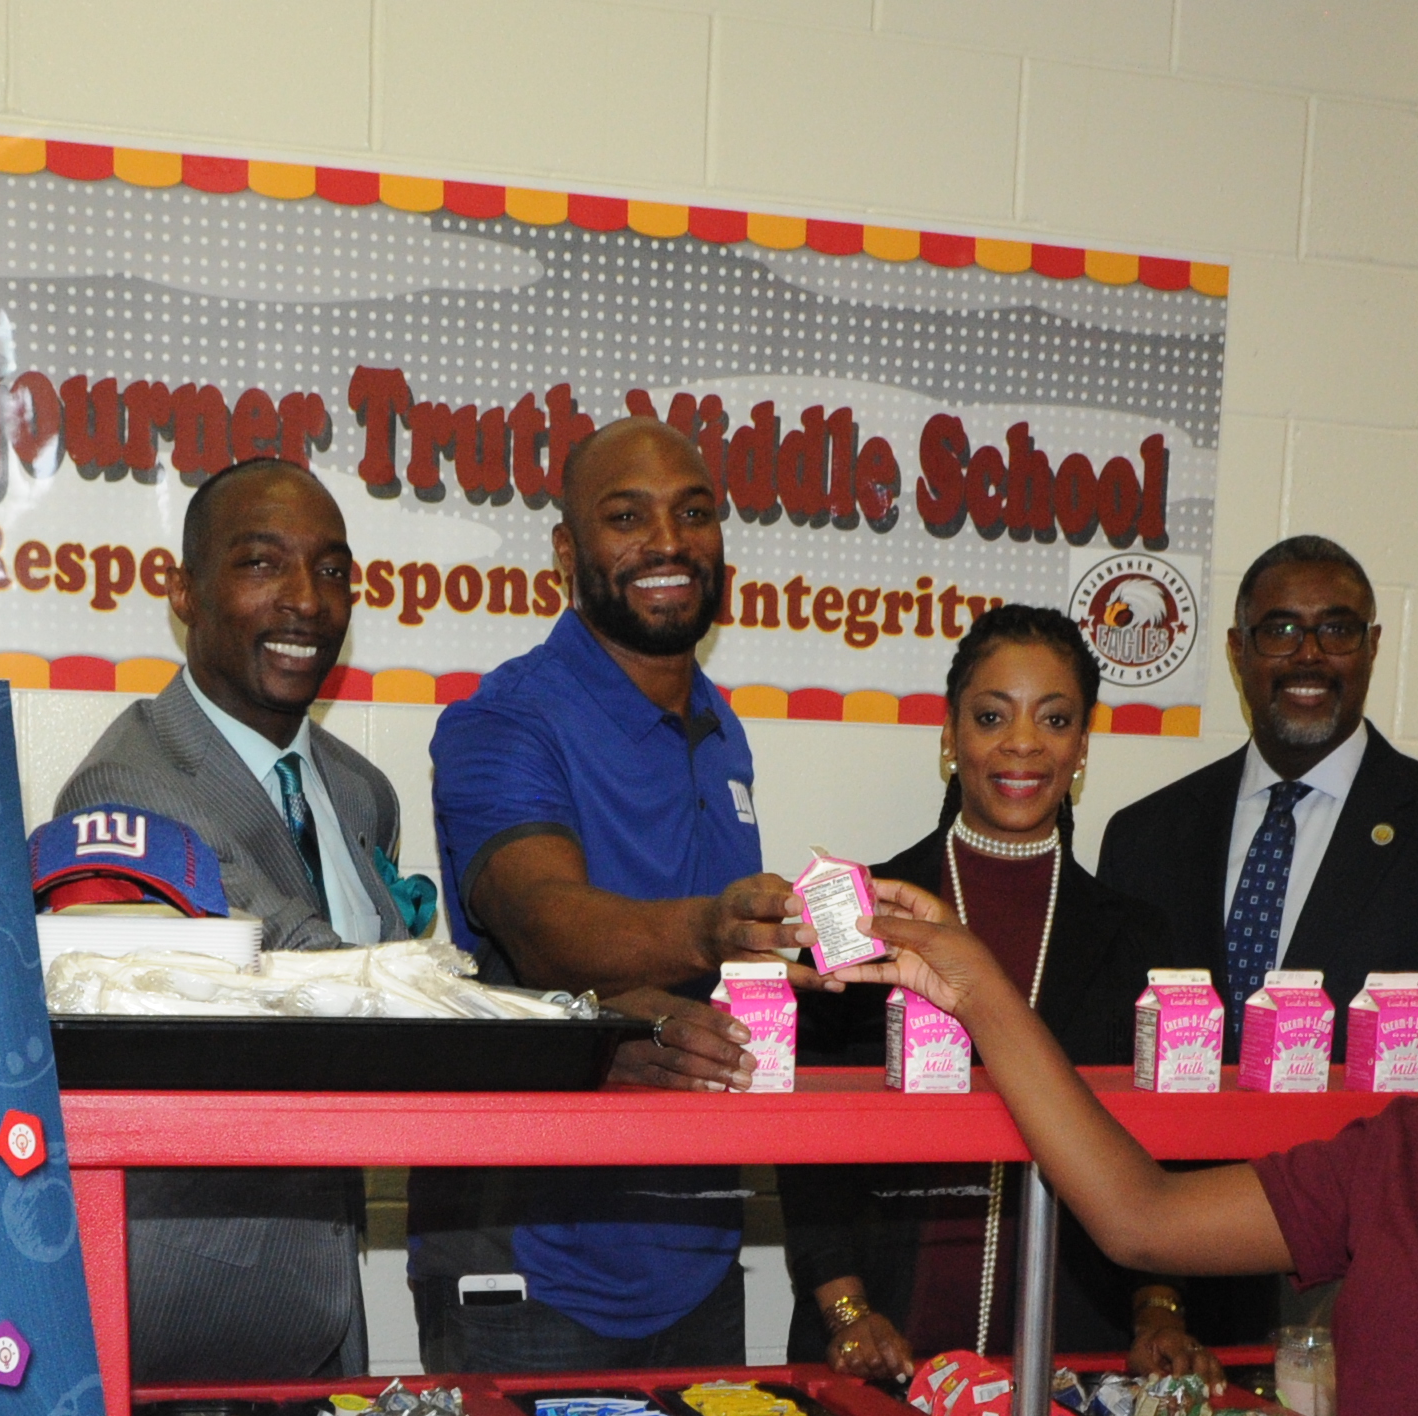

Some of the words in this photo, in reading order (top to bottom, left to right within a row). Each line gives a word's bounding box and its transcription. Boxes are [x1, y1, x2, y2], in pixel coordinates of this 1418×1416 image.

[348, 364, 596, 502] Truth
[915, 412, 1169, 549] School
[1078, 560, 1153, 607] SOJOURNER
[1163, 570, 1191, 613] TRUTH
[1096, 625, 1169, 663] EAGLES
[923, 1059, 954, 1073] Milk
[1174, 1062, 1205, 1076] Milk
[1287, 1063, 1316, 1076] Milk
[1390, 1062, 1418, 1075] Milk
